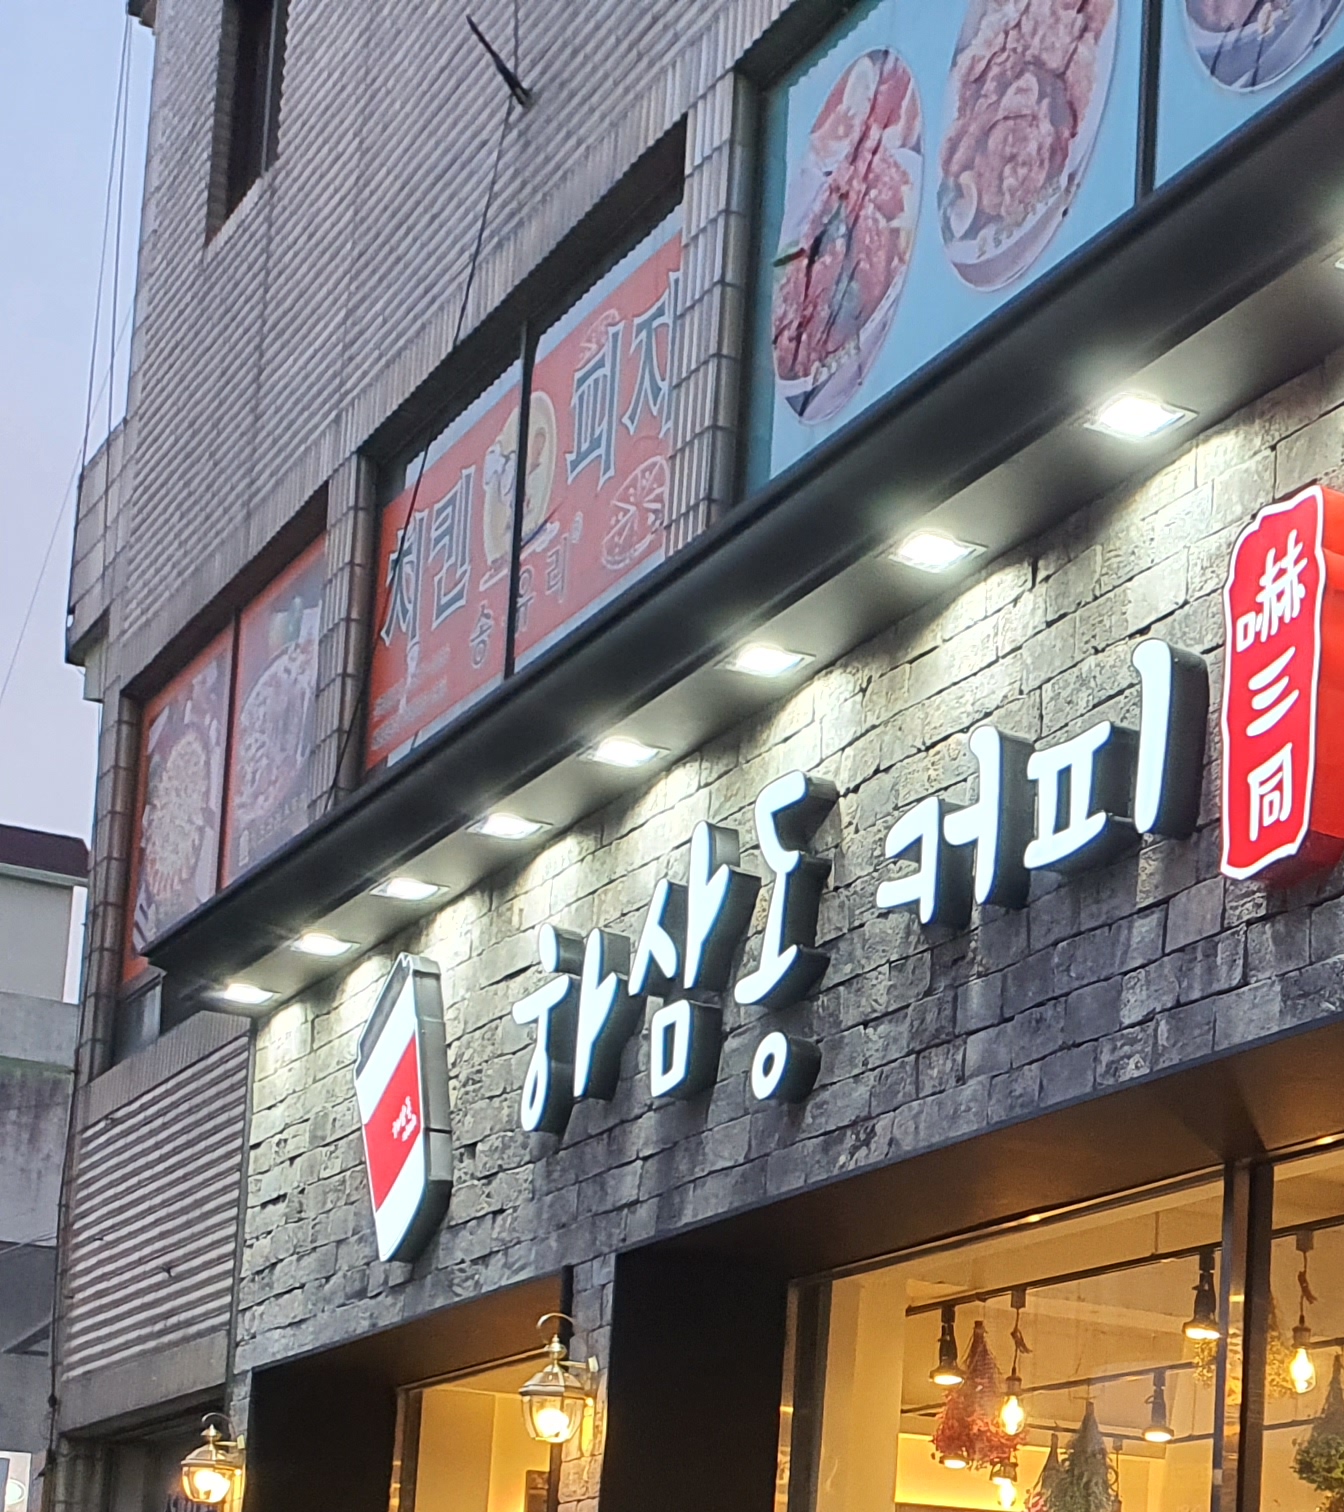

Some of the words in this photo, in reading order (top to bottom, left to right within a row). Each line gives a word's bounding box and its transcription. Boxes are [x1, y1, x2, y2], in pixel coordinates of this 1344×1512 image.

[380, 466, 474, 647] 치킨
[566, 270, 680, 490] 피자
[512, 769, 814, 1134] 하삼동
[876, 638, 1173, 925] 커피
